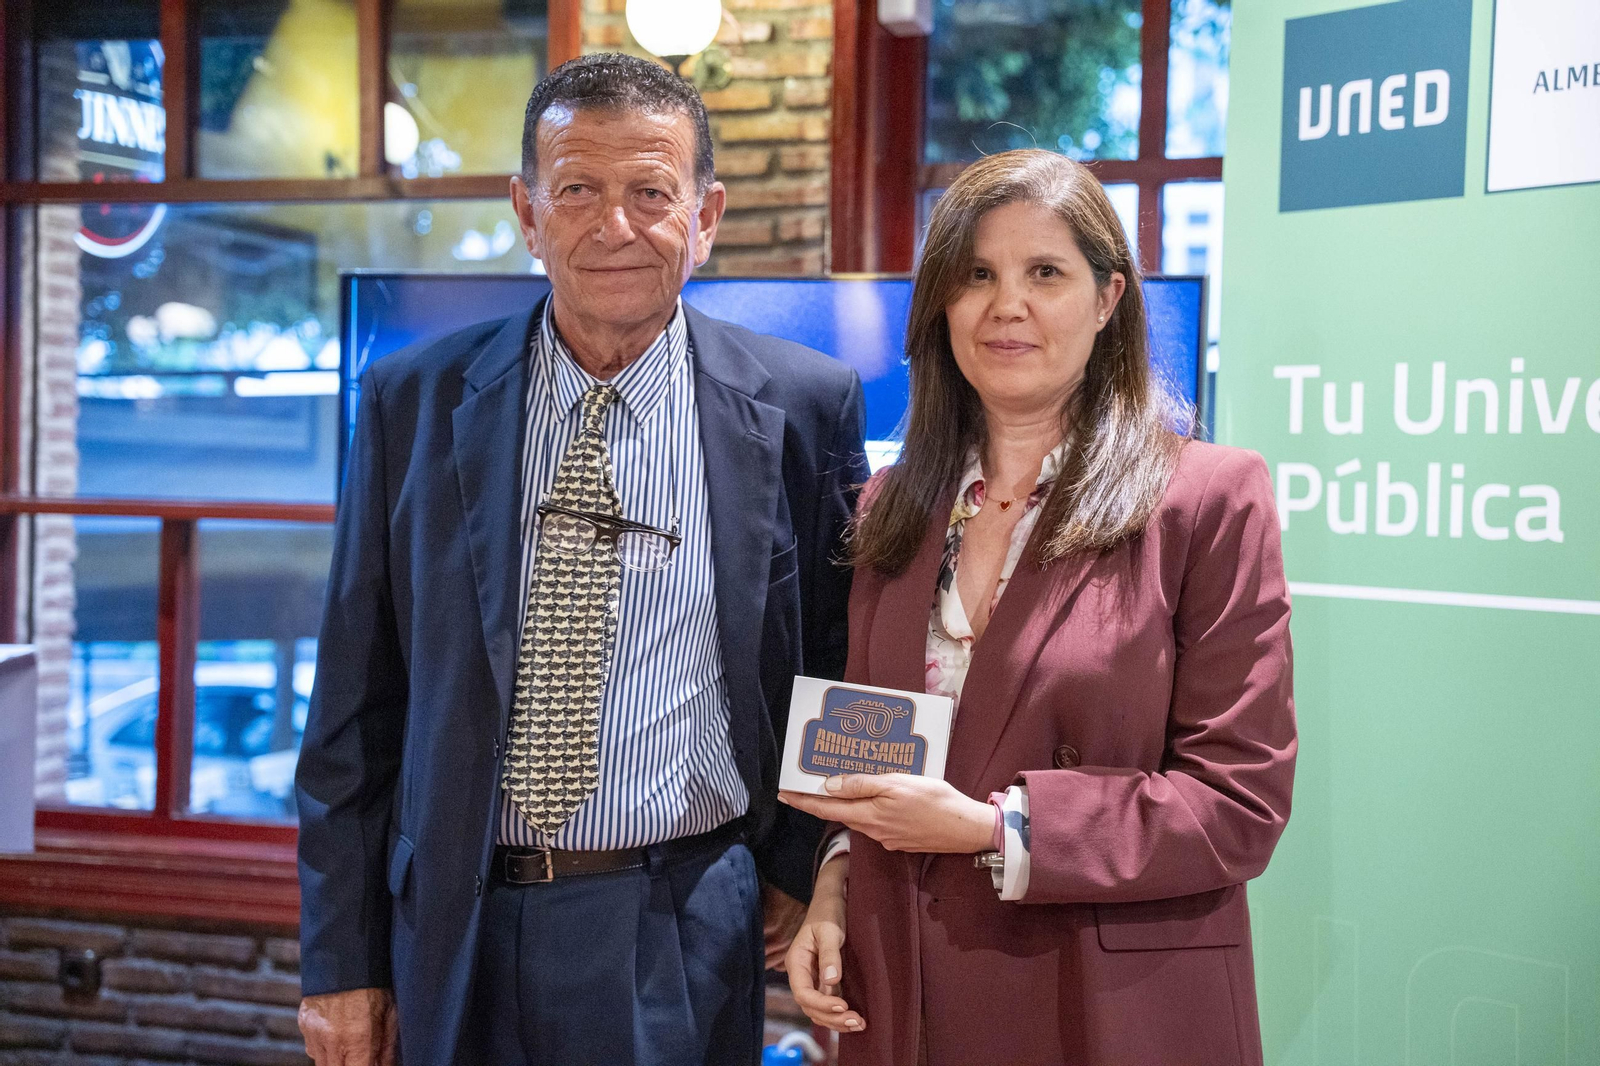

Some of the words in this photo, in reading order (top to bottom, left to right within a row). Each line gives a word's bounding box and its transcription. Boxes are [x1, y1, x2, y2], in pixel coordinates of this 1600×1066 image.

[1298, 69, 1450, 141] UNED
[1273, 364, 1365, 435] Tu
[1276, 458, 1564, 543] Pública
[811, 754, 840, 769] RALLYE
[840, 758, 864, 773] COSTA
[864, 762, 876, 774] DE
[813, 728, 916, 766] ANIVERSARIO
